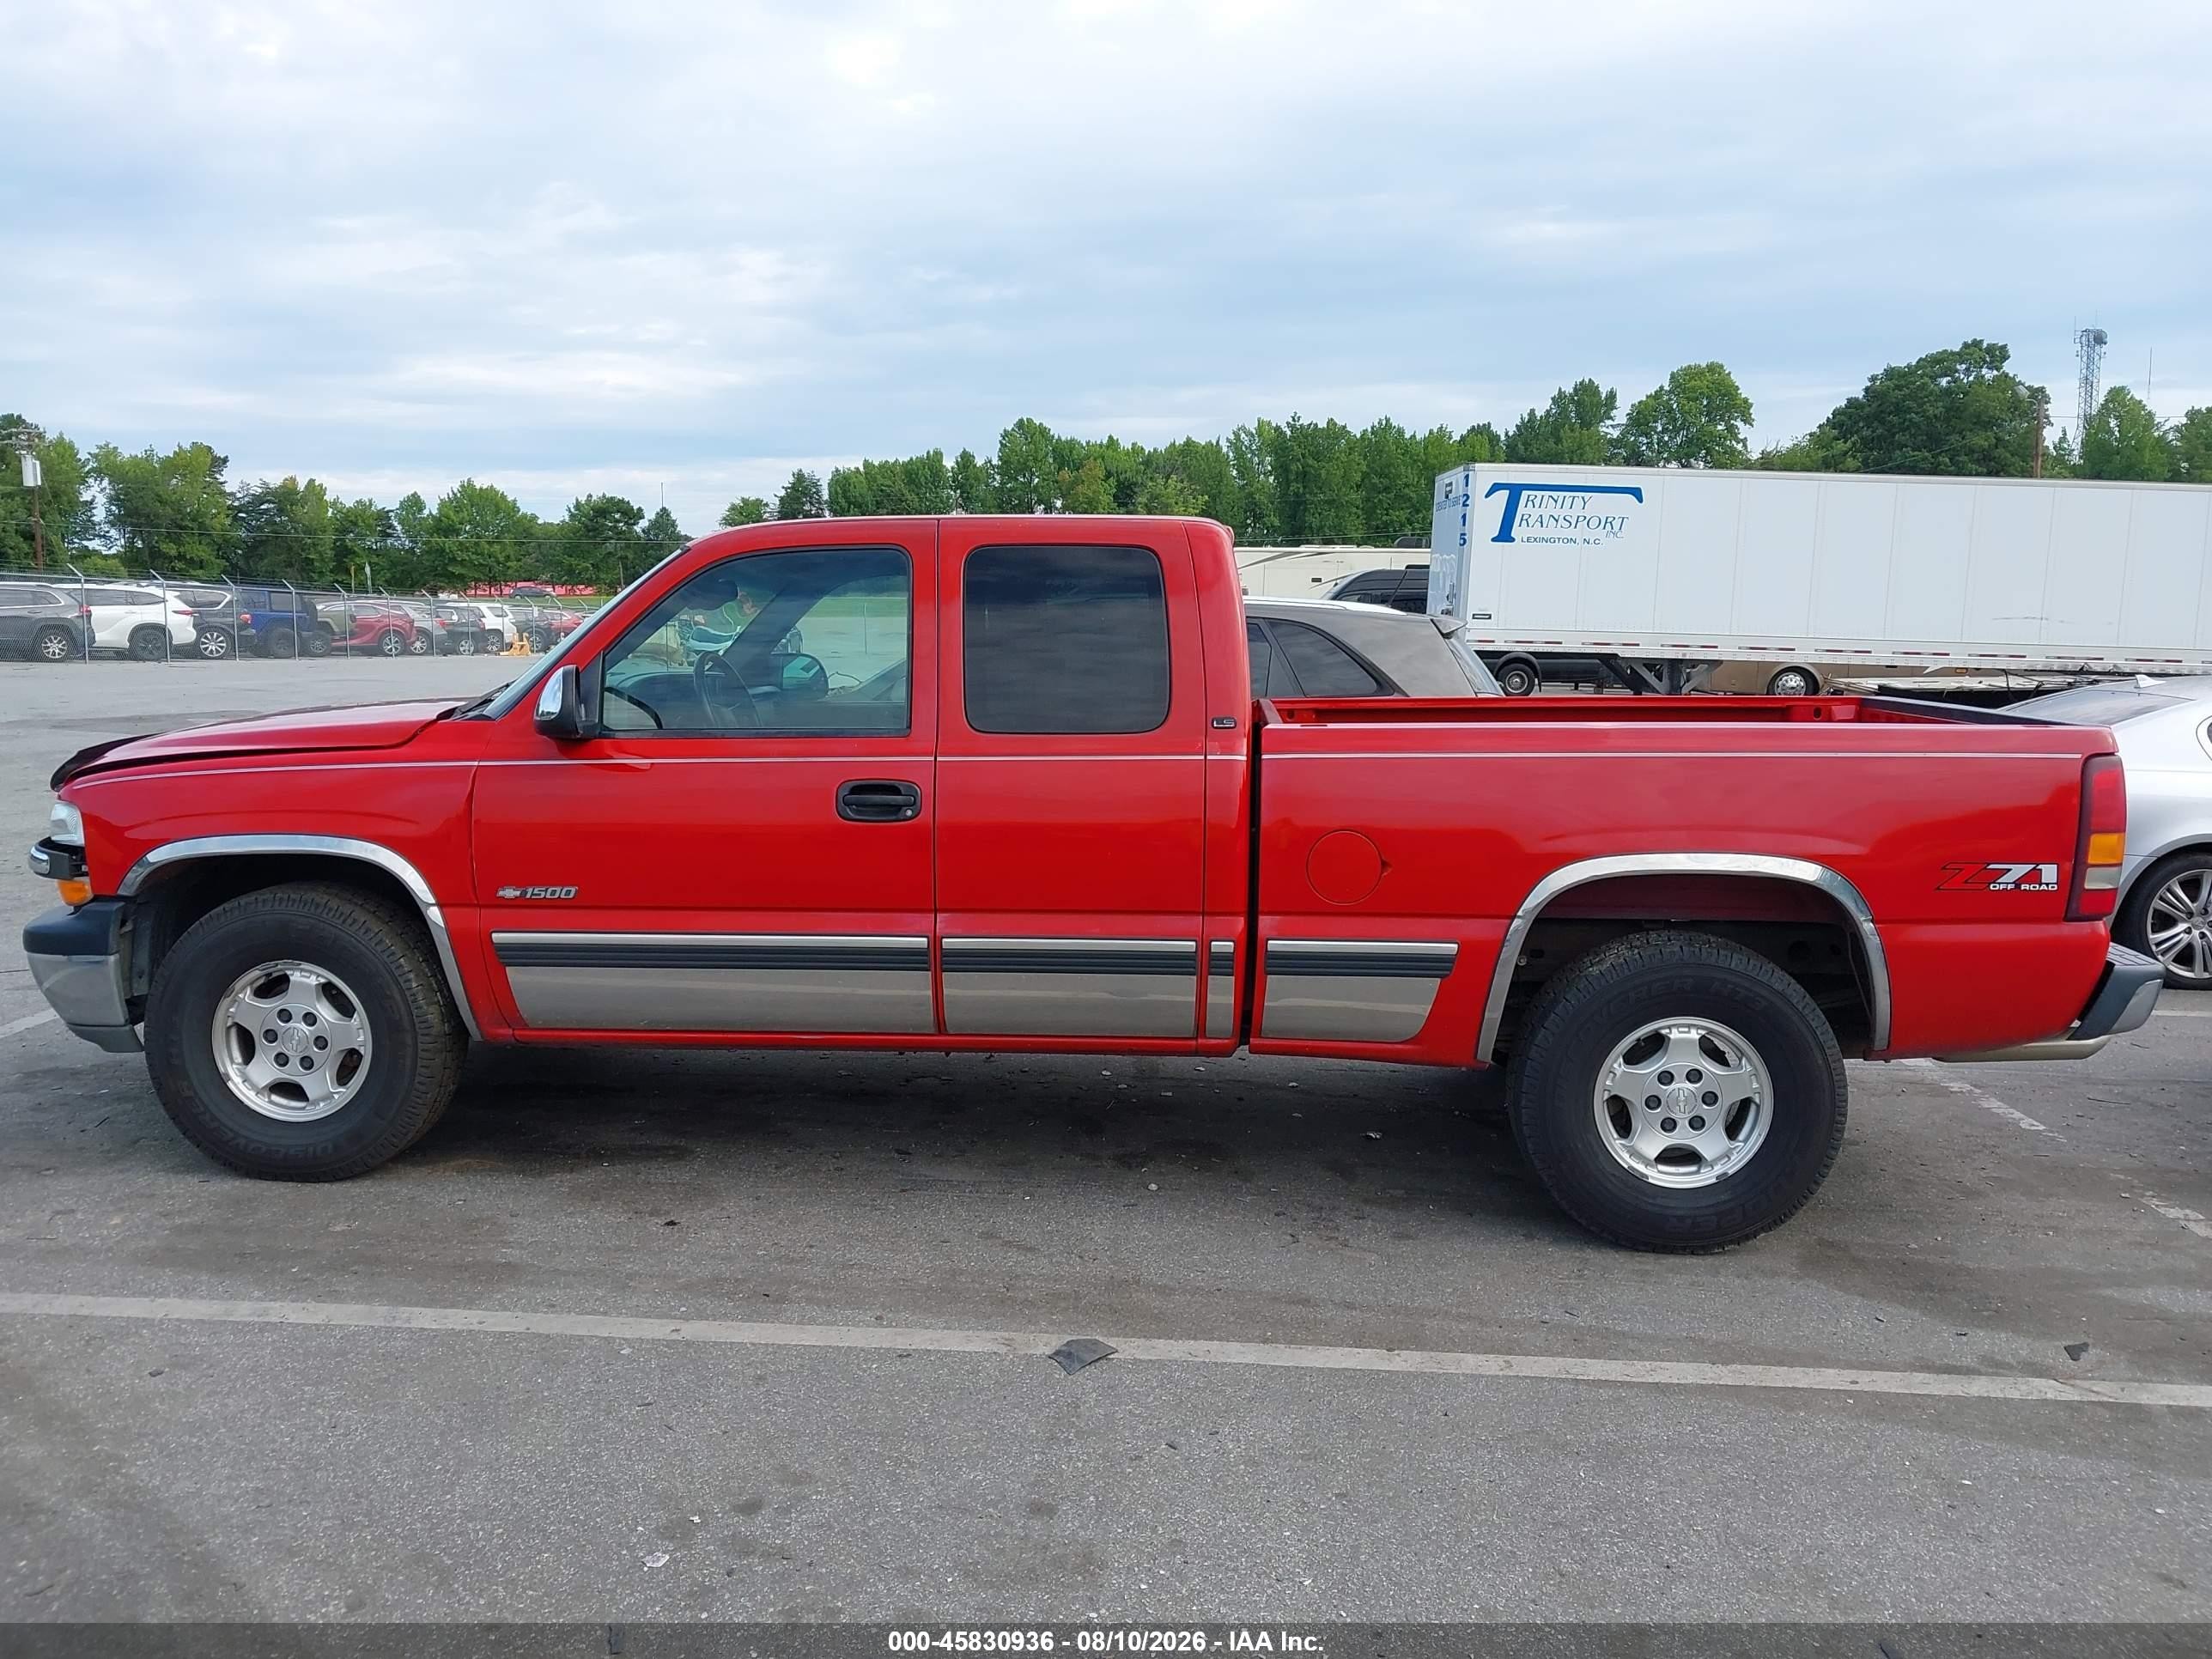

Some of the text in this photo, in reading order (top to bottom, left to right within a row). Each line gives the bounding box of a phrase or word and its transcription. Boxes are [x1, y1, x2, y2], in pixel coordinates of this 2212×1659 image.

[1521, 536, 1580, 545] LEXINGTON,
[1213, 719, 1235, 727] LS
[1936, 862, 2058, 890] Z71
[525, 886, 578, 899] 1500
